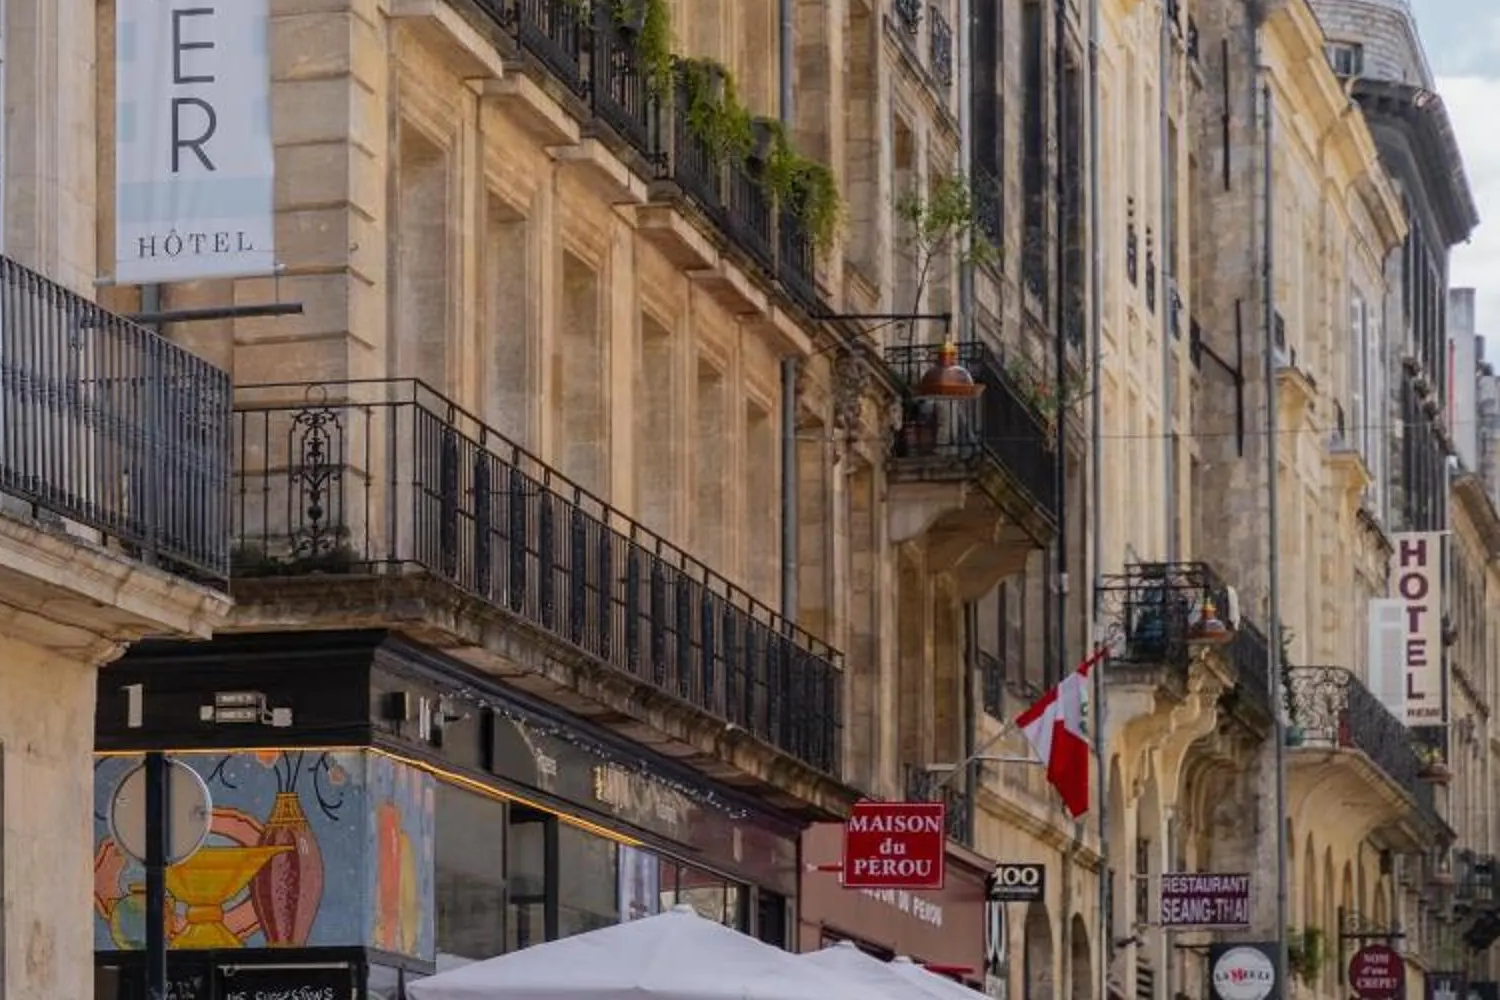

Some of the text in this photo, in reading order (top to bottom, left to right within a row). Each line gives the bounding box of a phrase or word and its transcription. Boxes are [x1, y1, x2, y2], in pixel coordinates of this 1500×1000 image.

[137, 228, 253, 259] HÔTEL
[1399, 539, 1429, 700] HOTEL
[850, 814, 940, 834] MAISON
[879, 838, 906, 856] du
[991, 866, 1039, 886] 100
[1161, 877, 1248, 893] RESTAURANT
[1161, 897, 1248, 923] SEANG-THAI
